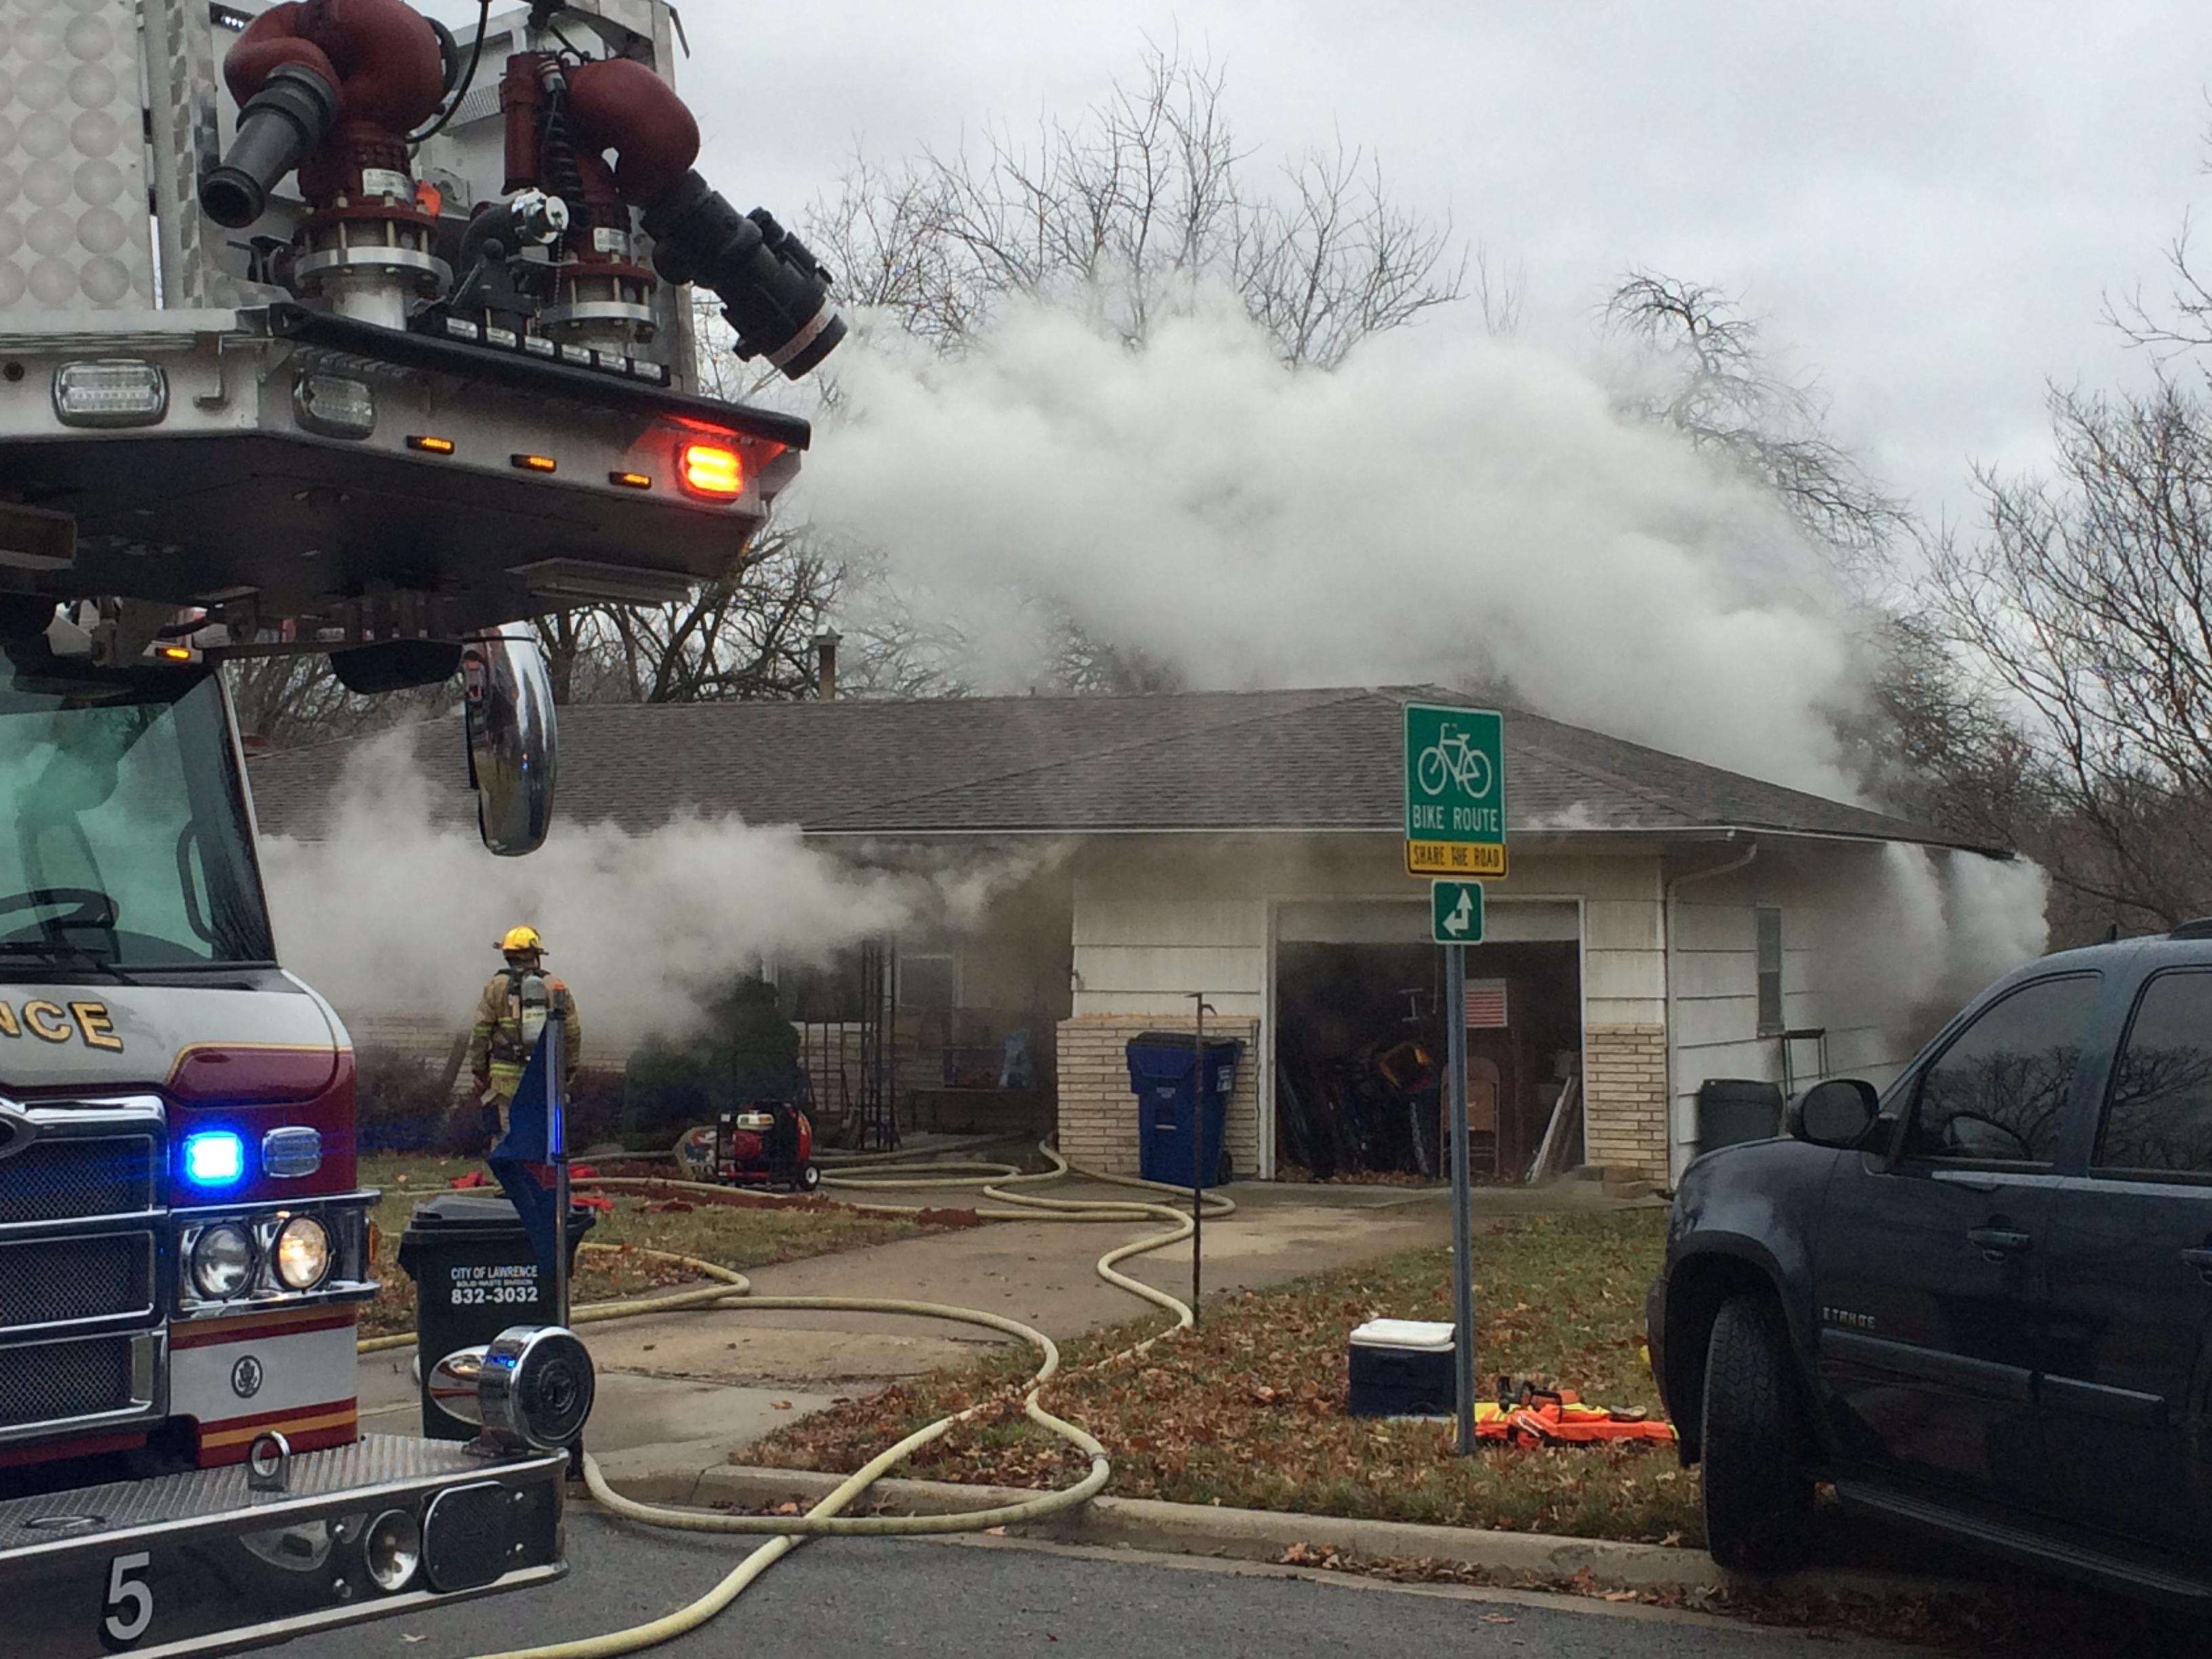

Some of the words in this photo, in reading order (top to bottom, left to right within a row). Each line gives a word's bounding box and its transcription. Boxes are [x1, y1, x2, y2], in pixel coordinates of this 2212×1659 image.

[1412, 804, 1444, 829] BIKE
[1454, 807, 1499, 832] ROUTE
[1414, 844, 1445, 865] SHARE
[1450, 846, 1468, 867] THE
[1474, 847, 1499, 867] ROAD
[451, 1267, 472, 1279] CITY
[474, 1266, 486, 1278] OF
[488, 1265, 538, 1278] LAWRENCE
[451, 1287, 538, 1304] 832-3032
[105, 1551, 154, 1641] 5
